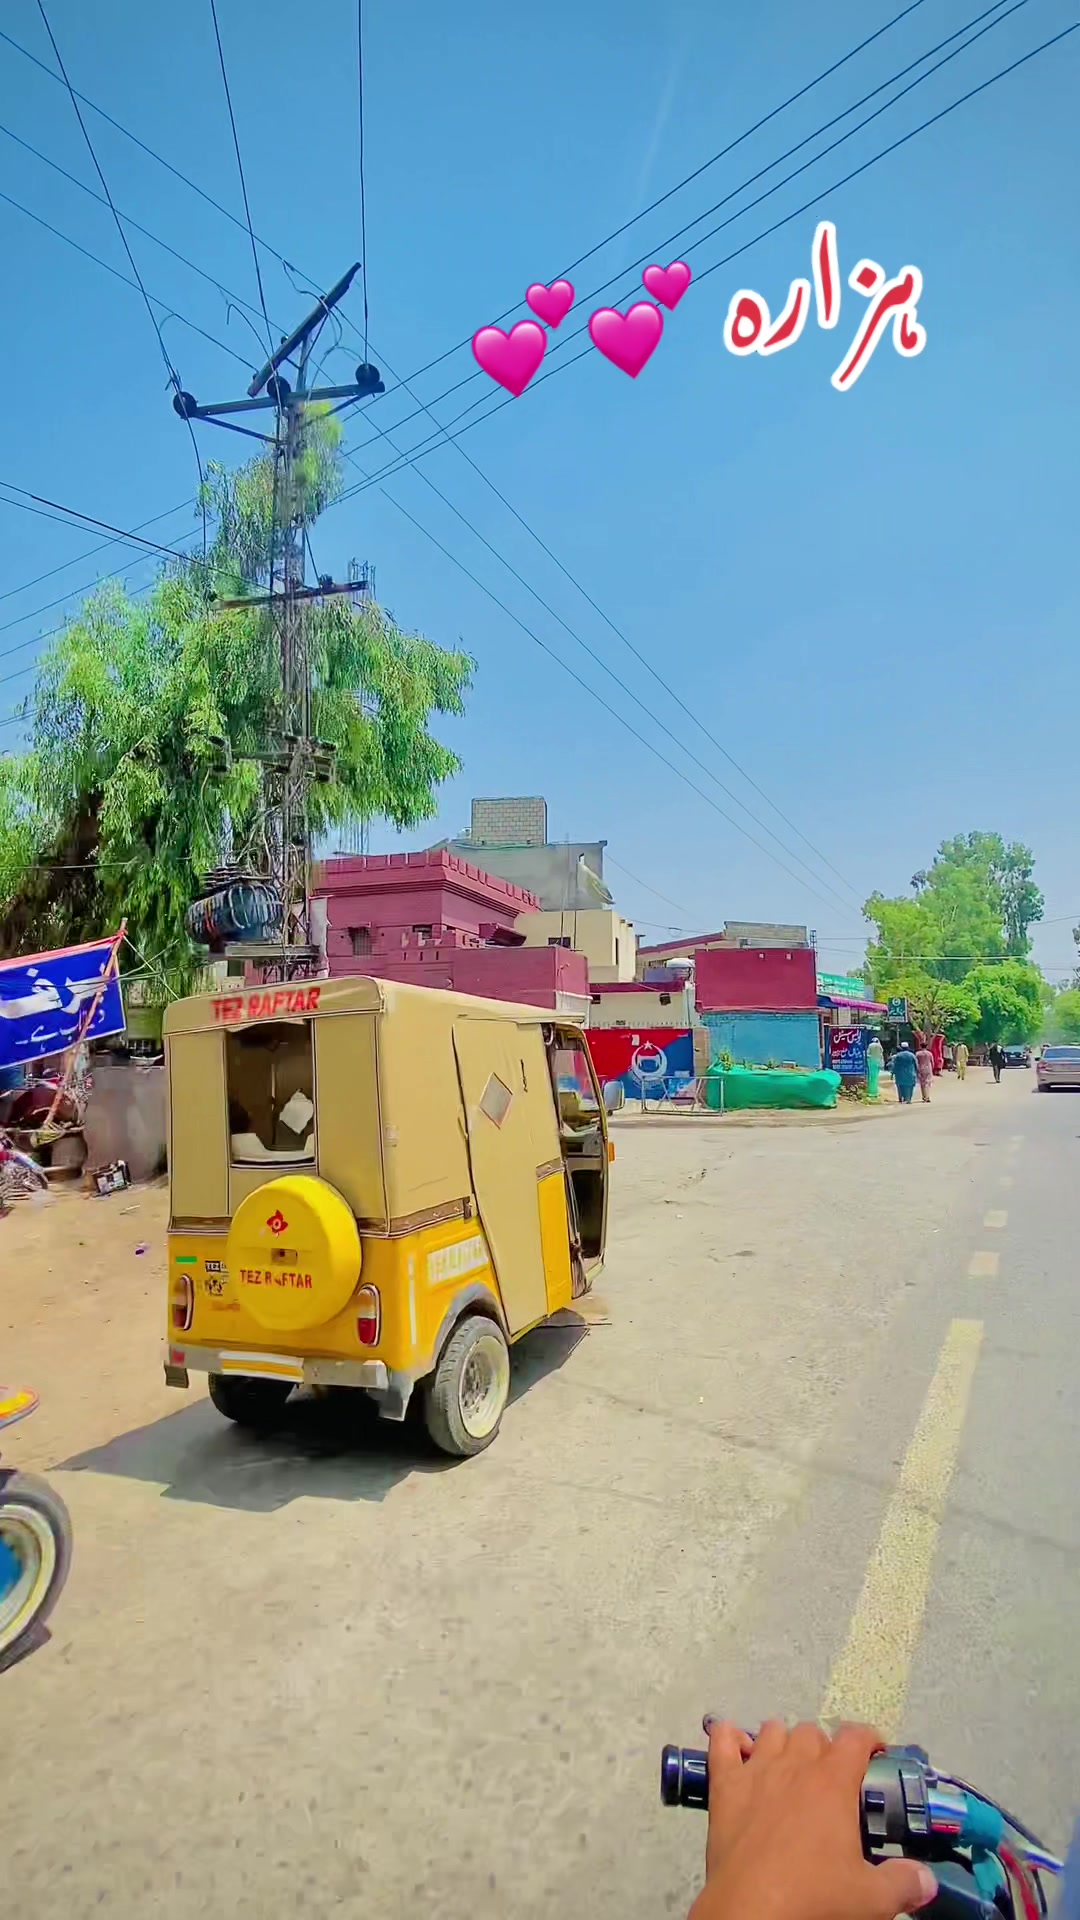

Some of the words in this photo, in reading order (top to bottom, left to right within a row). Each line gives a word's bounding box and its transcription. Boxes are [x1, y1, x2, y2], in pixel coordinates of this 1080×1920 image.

[211, 996, 242, 1020] TEZ
[247, 987, 320, 1017] RAFTAR
[240, 1269, 262, 1285] TEZ
